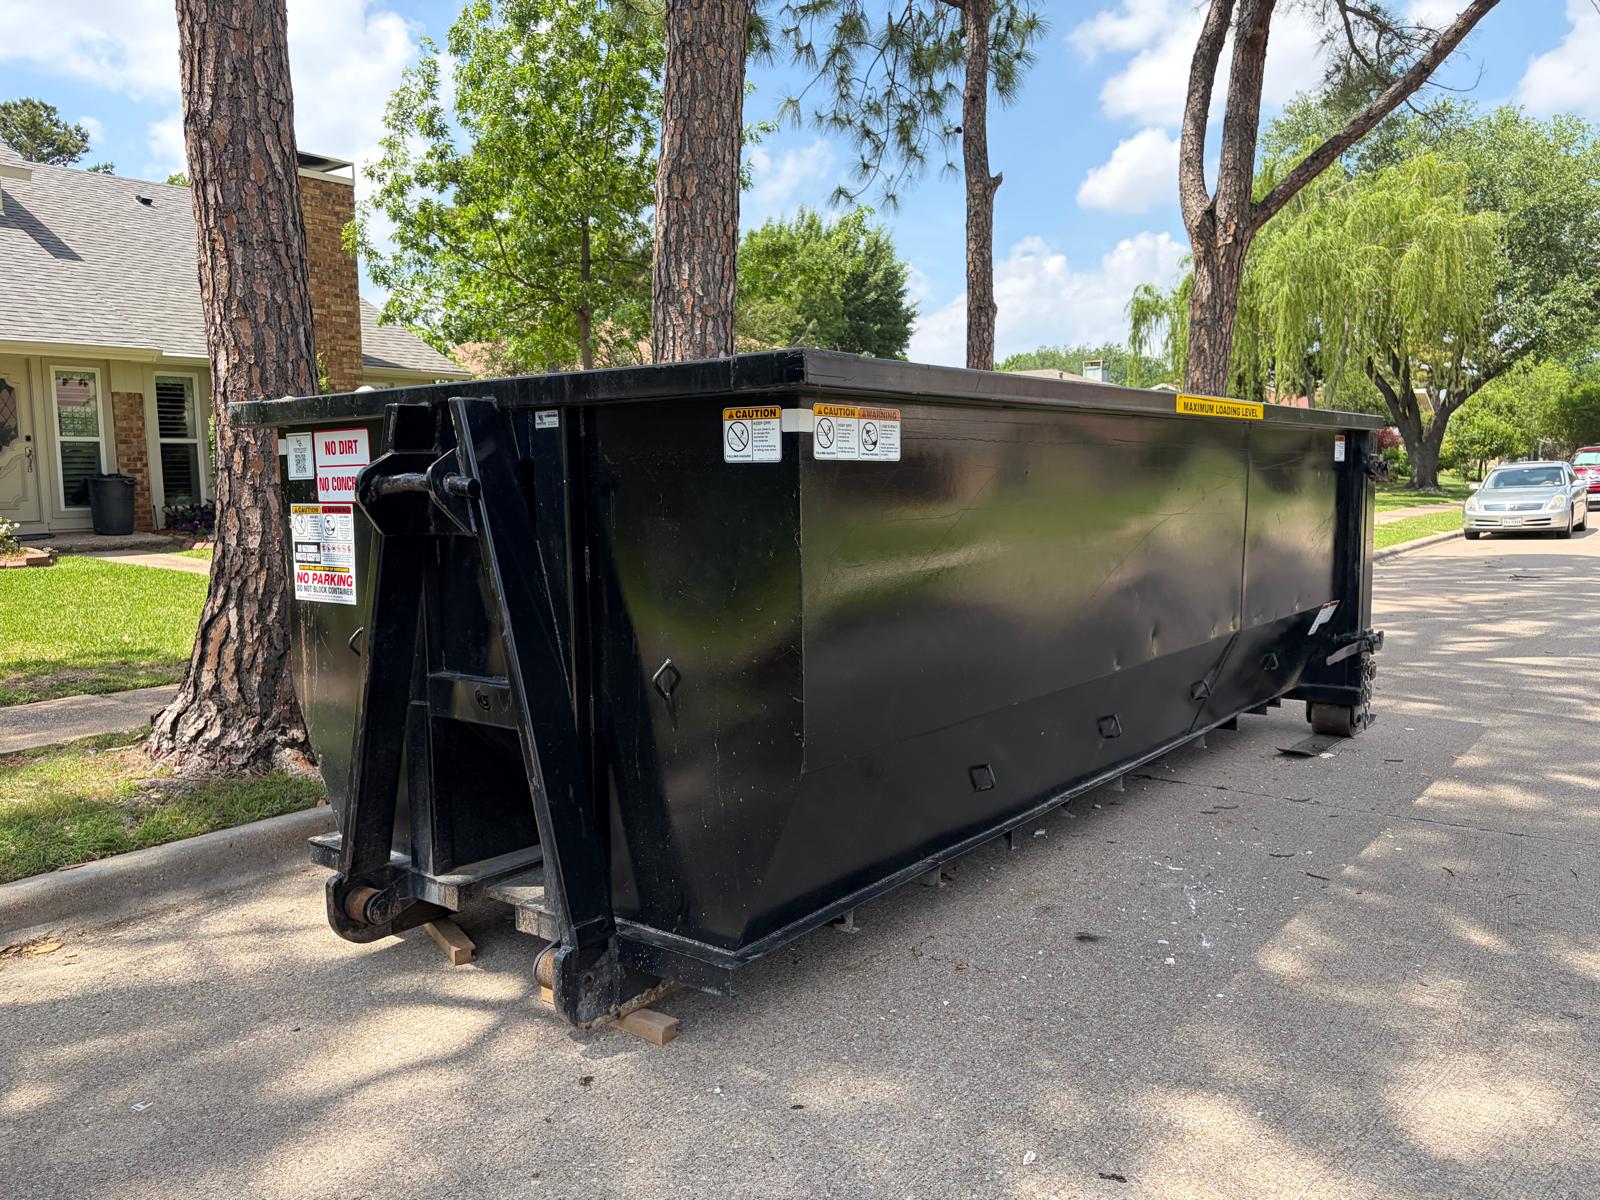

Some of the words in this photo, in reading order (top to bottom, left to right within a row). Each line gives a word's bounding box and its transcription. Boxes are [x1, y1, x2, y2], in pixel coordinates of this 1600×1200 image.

[735, 408, 777, 419] CAUTION
[823, 406, 856, 417] CAUTION
[866, 409, 897, 420] WARNING
[1183, 401, 1214, 414] MAXIMUM
[1215, 404, 1241, 417] LOADING
[1241, 408, 1258, 418] LEVEL
[324, 440, 336, 456] NO
[338, 439, 359, 455] DIRT
[319, 477, 330, 491] NO
[296, 572, 310, 584] NO
[311, 573, 353, 587] PARKING
[303, 585, 312, 593] NOT
[313, 585, 328, 594] BLOCK
[328, 586, 354, 596] CONTAINER
